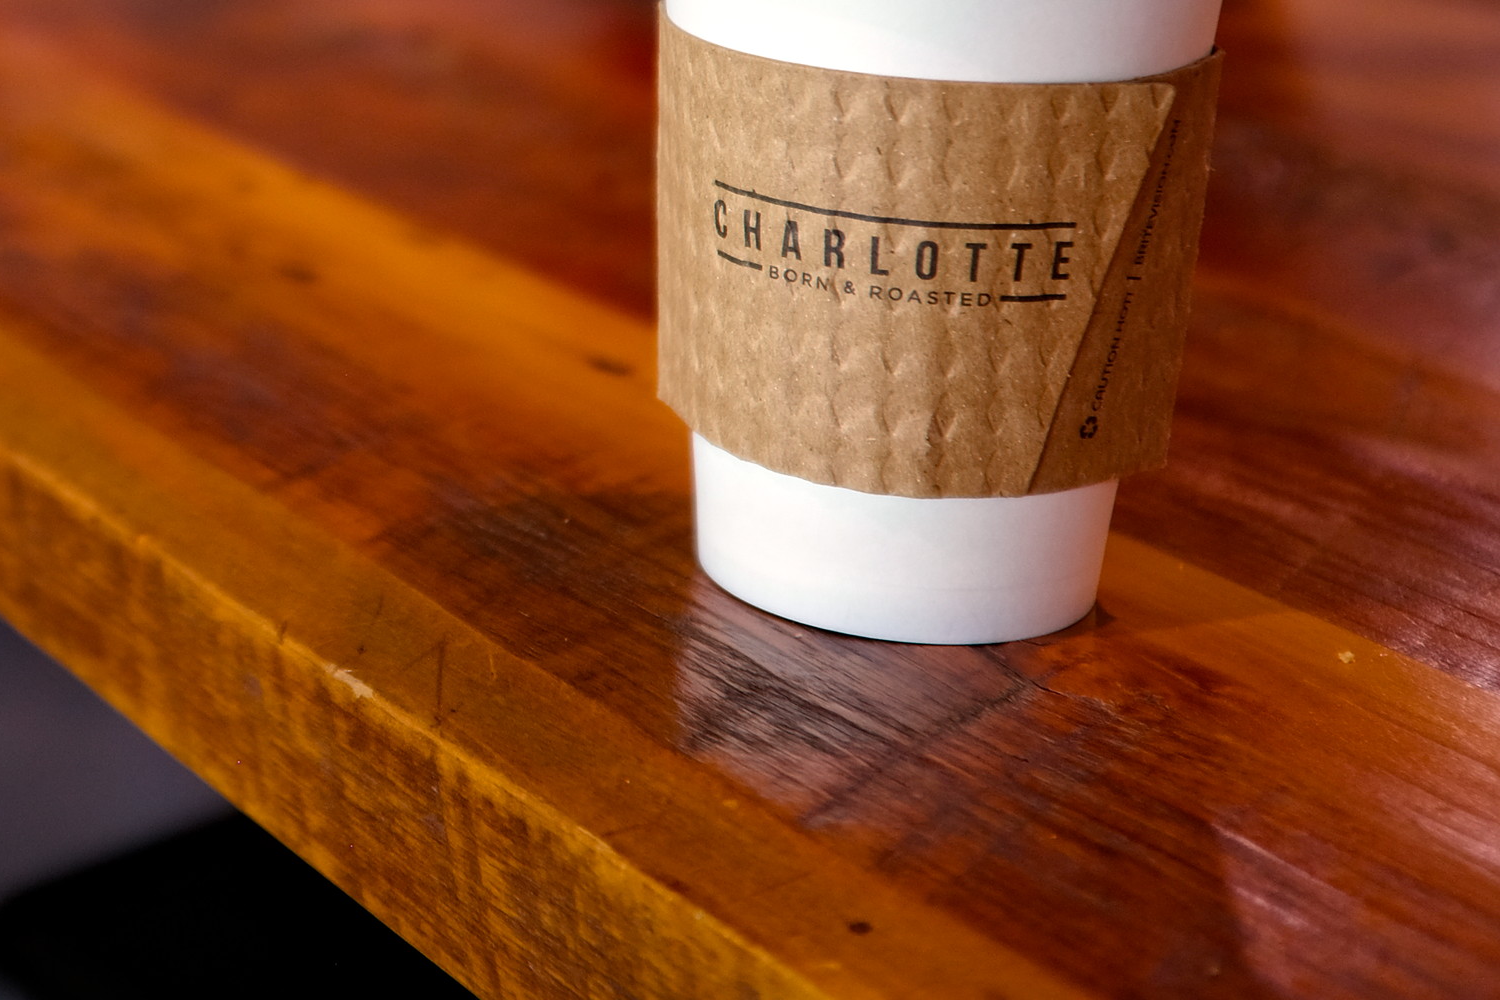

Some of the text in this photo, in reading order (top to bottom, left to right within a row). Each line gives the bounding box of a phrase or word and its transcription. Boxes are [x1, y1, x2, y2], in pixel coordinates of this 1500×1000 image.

[713, 199, 1075, 283] CHARLOTTE
[768, 265, 992, 307] BORN & ROASTED
[1092, 337, 1120, 411] CAUTION
